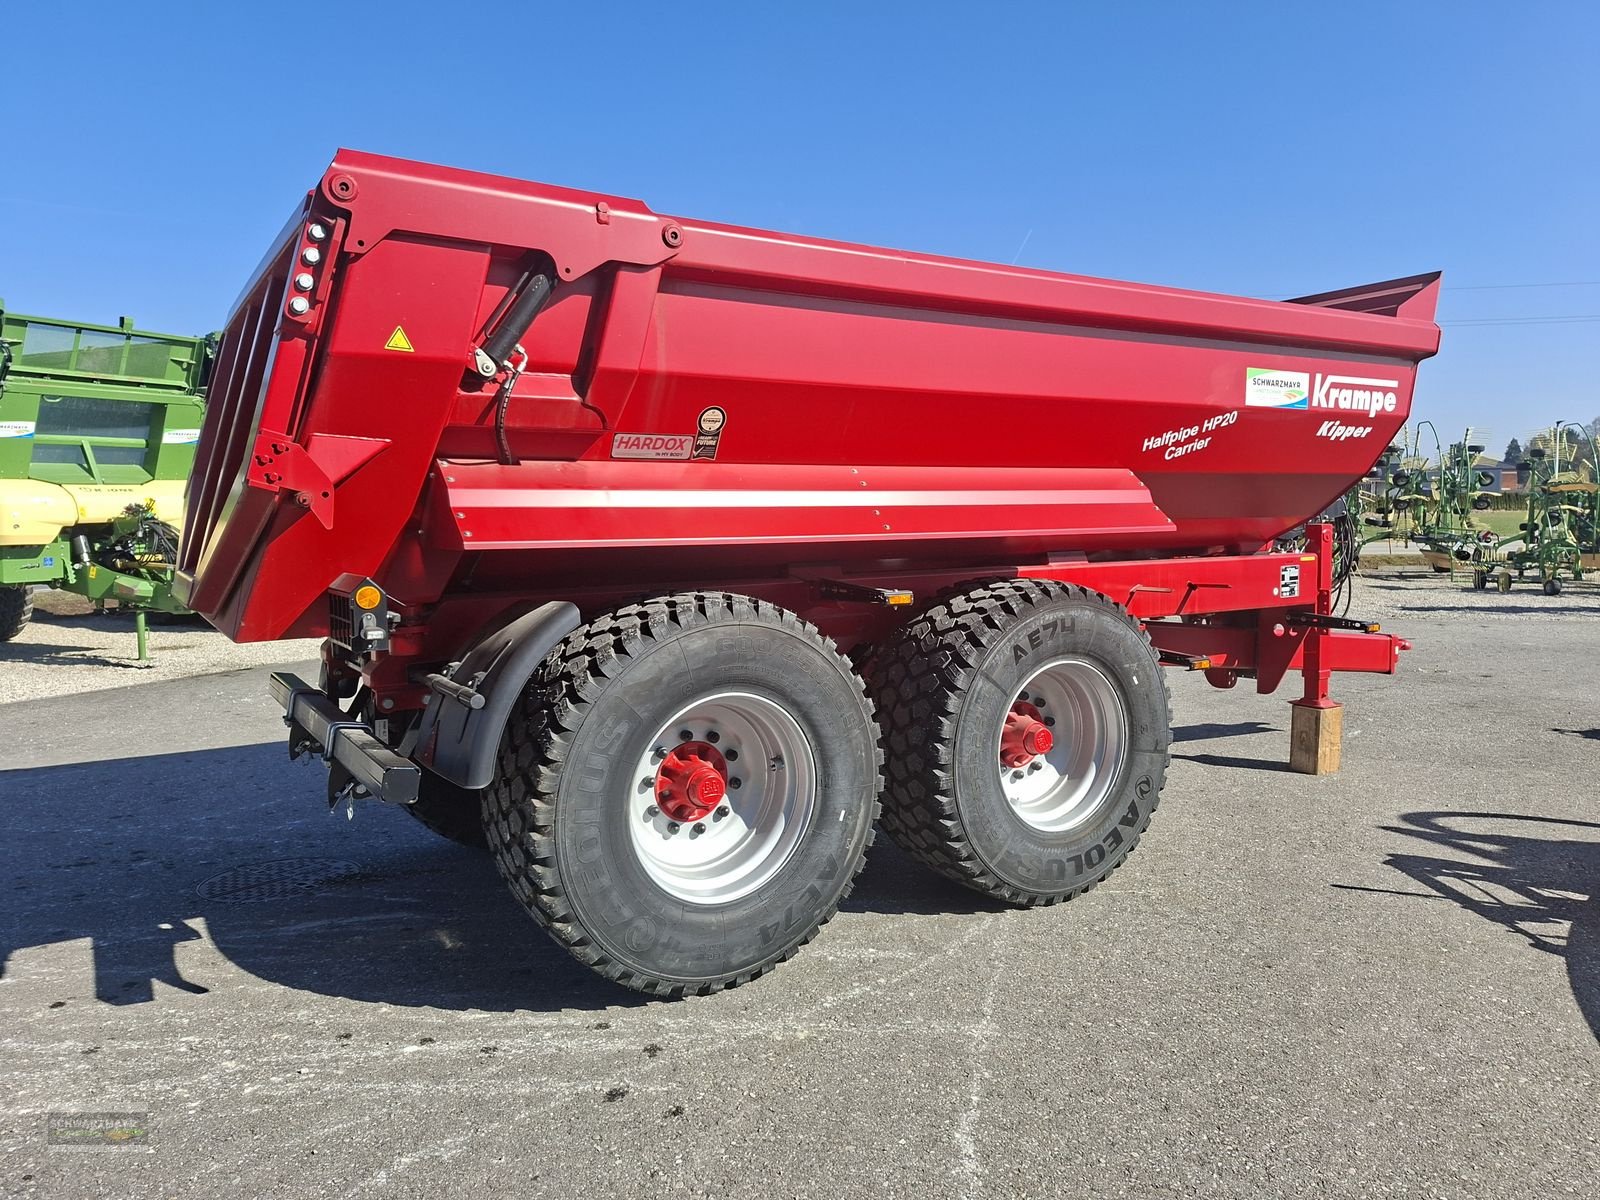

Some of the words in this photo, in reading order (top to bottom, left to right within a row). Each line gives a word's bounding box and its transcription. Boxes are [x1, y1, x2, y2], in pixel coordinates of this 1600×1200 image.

[1252, 377, 1301, 389] SCHWARZMAYR
[1311, 372, 1399, 418] Krampe
[616, 436, 688, 451] HARDOX
[1142, 425, 1200, 452] Halfpipe
[1202, 410, 1238, 433] HP20
[1164, 436, 1212, 461] Carrier
[1316, 420, 1373, 441] Kipper
[1013, 617, 1076, 666] AE74
[574, 714, 635, 927] AEOLUS
[1017, 799, 1140, 882] AEOLUS
[758, 853, 839, 946] AE74
